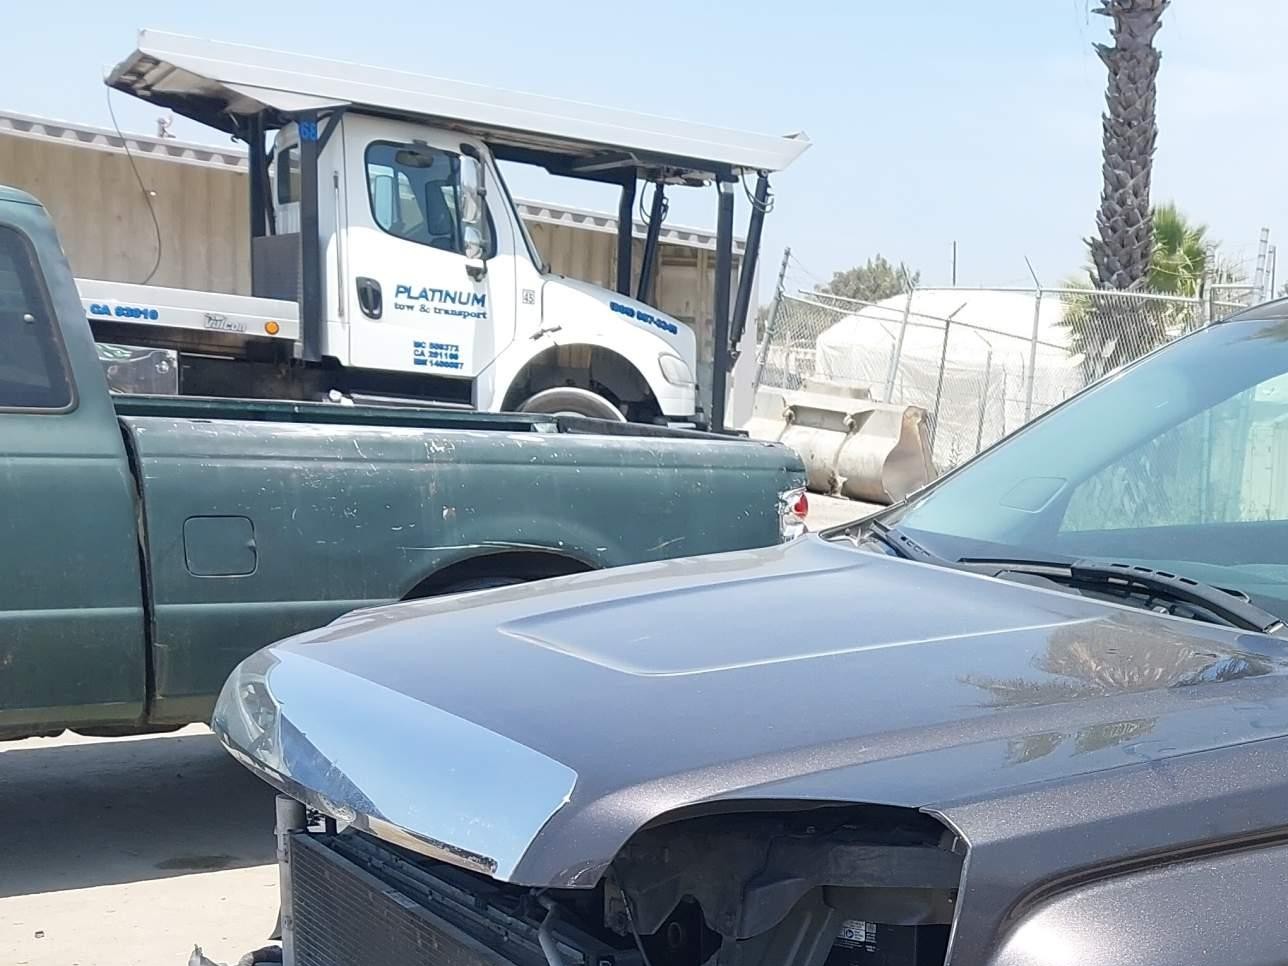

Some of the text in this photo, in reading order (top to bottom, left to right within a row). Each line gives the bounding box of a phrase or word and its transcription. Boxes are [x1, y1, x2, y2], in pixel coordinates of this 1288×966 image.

[394, 284, 487, 308] PLATINUM
[90, 303, 112, 317] CA
[394, 302, 488, 320] tow & transport
